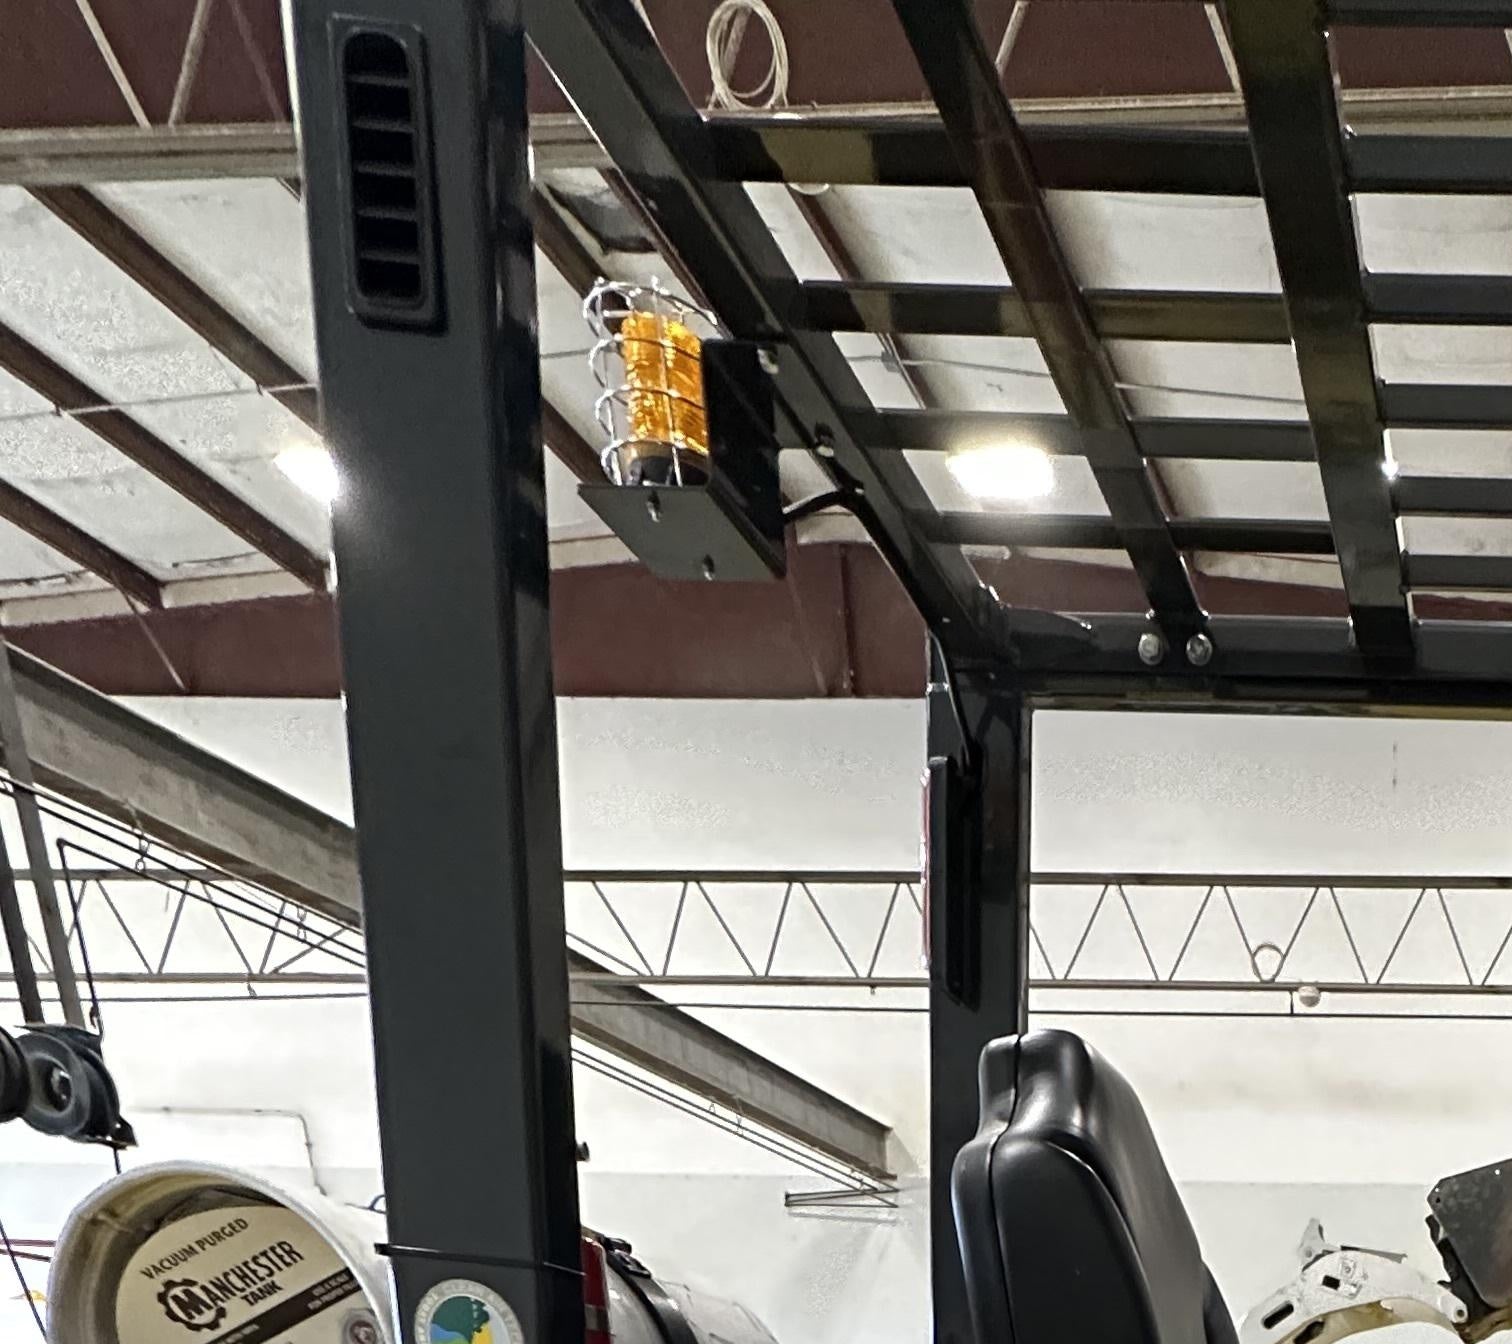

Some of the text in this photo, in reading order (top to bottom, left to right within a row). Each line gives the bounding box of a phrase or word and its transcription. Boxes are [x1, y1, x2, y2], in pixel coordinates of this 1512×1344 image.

[141, 1218, 249, 1280] VACUUM PURGED
[170, 1240, 305, 1321] MANCHESTER
[240, 1280, 284, 1307] TANK
